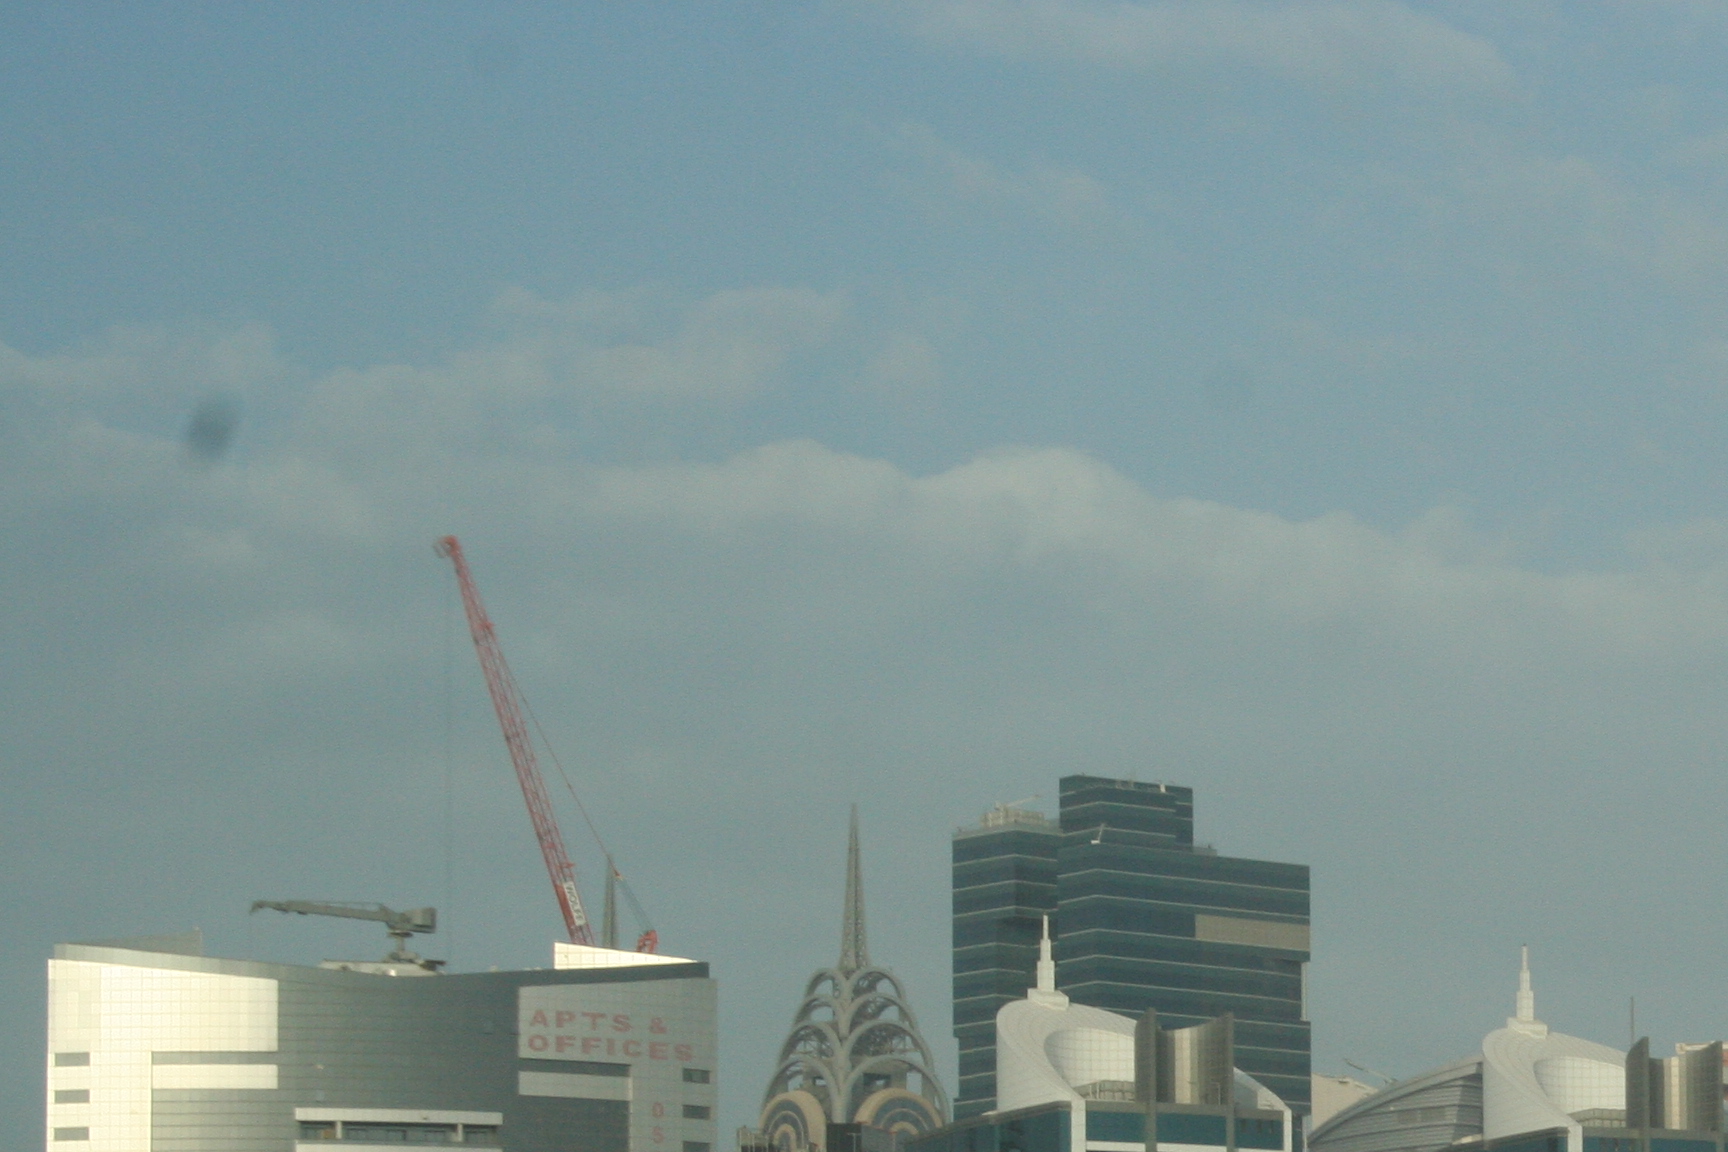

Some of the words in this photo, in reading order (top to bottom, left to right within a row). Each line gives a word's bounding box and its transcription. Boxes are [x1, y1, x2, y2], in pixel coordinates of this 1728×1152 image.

[529, 1009, 633, 1032] APTS
[650, 1017, 668, 1034] &
[528, 1034, 694, 1062] OFFICES
